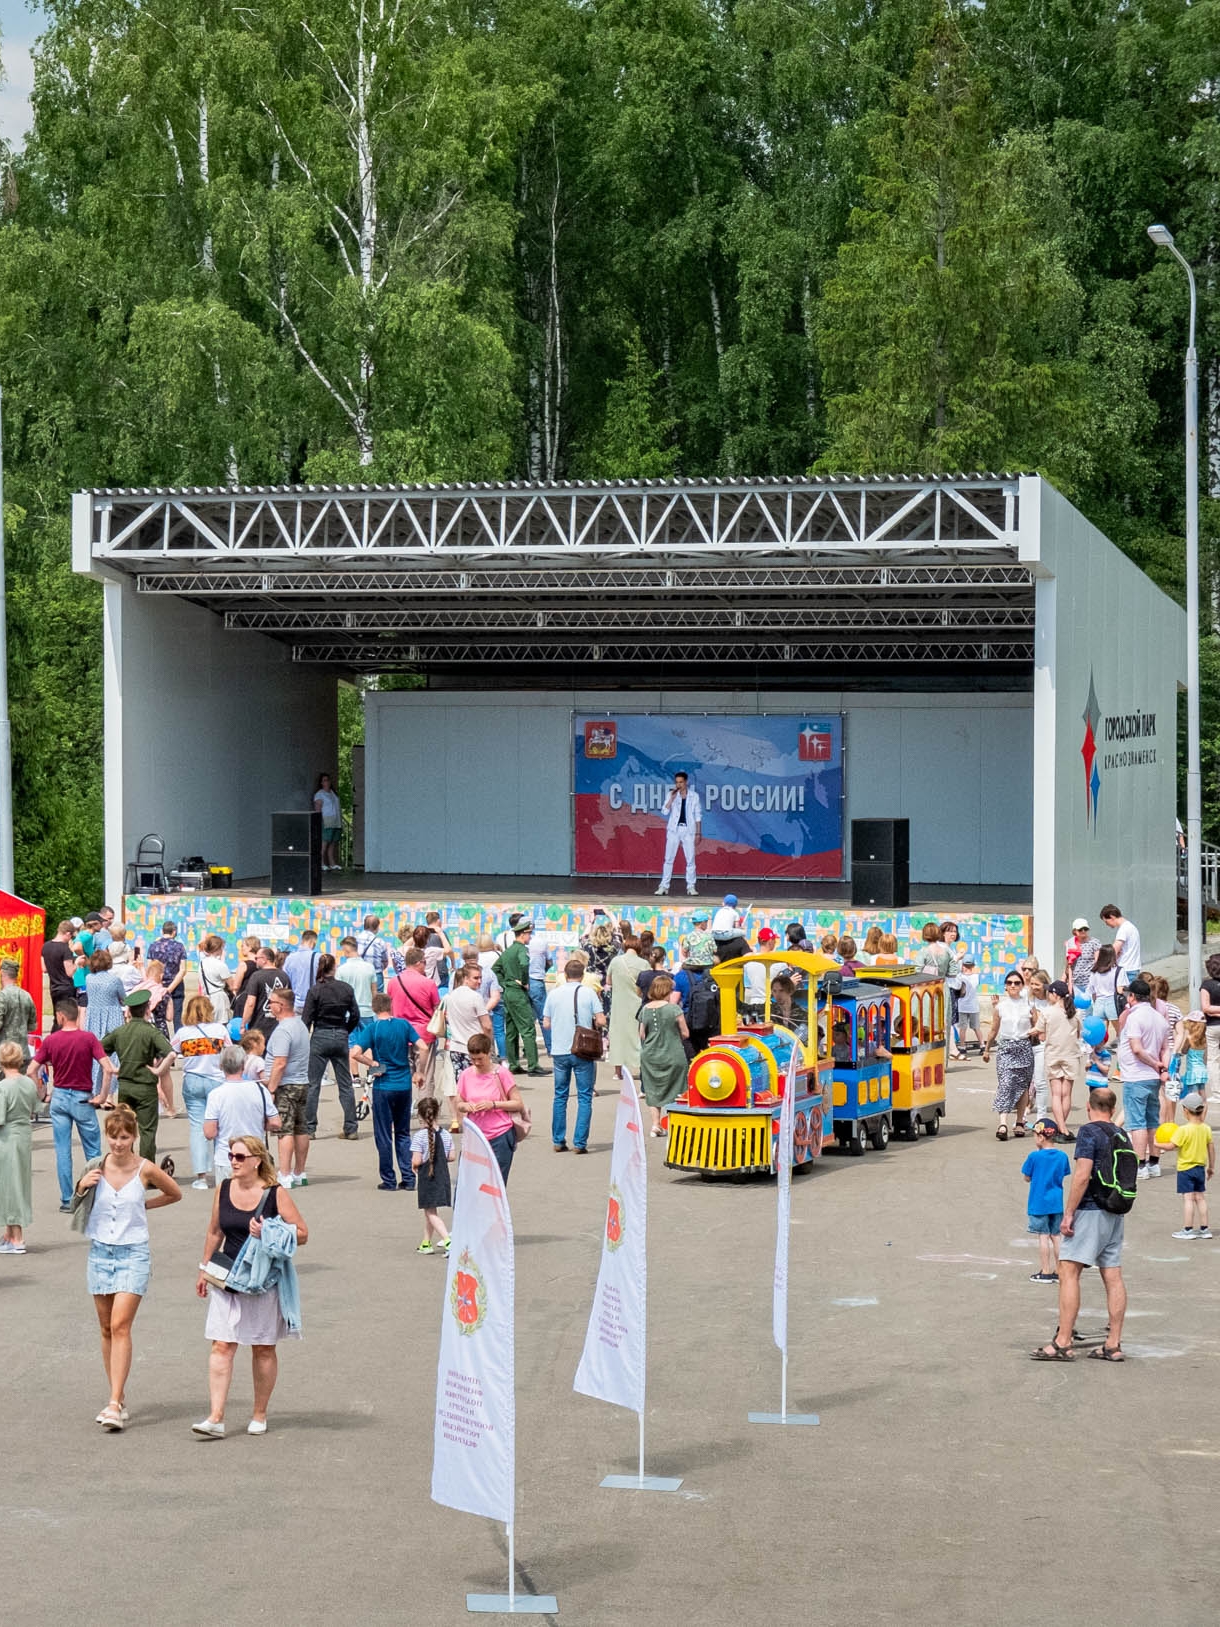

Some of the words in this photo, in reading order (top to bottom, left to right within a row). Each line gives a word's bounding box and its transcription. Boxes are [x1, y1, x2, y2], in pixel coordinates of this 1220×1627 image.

[1105, 709, 1140, 742] ГОРОДСКОЙ
[1142, 713, 1156, 737] ПАРК
[1104, 749, 1156, 769] КРАСНОЗНАМЕНСК
[609, 783, 622, 809] С
[705, 784, 804, 812] РОССИИ!
